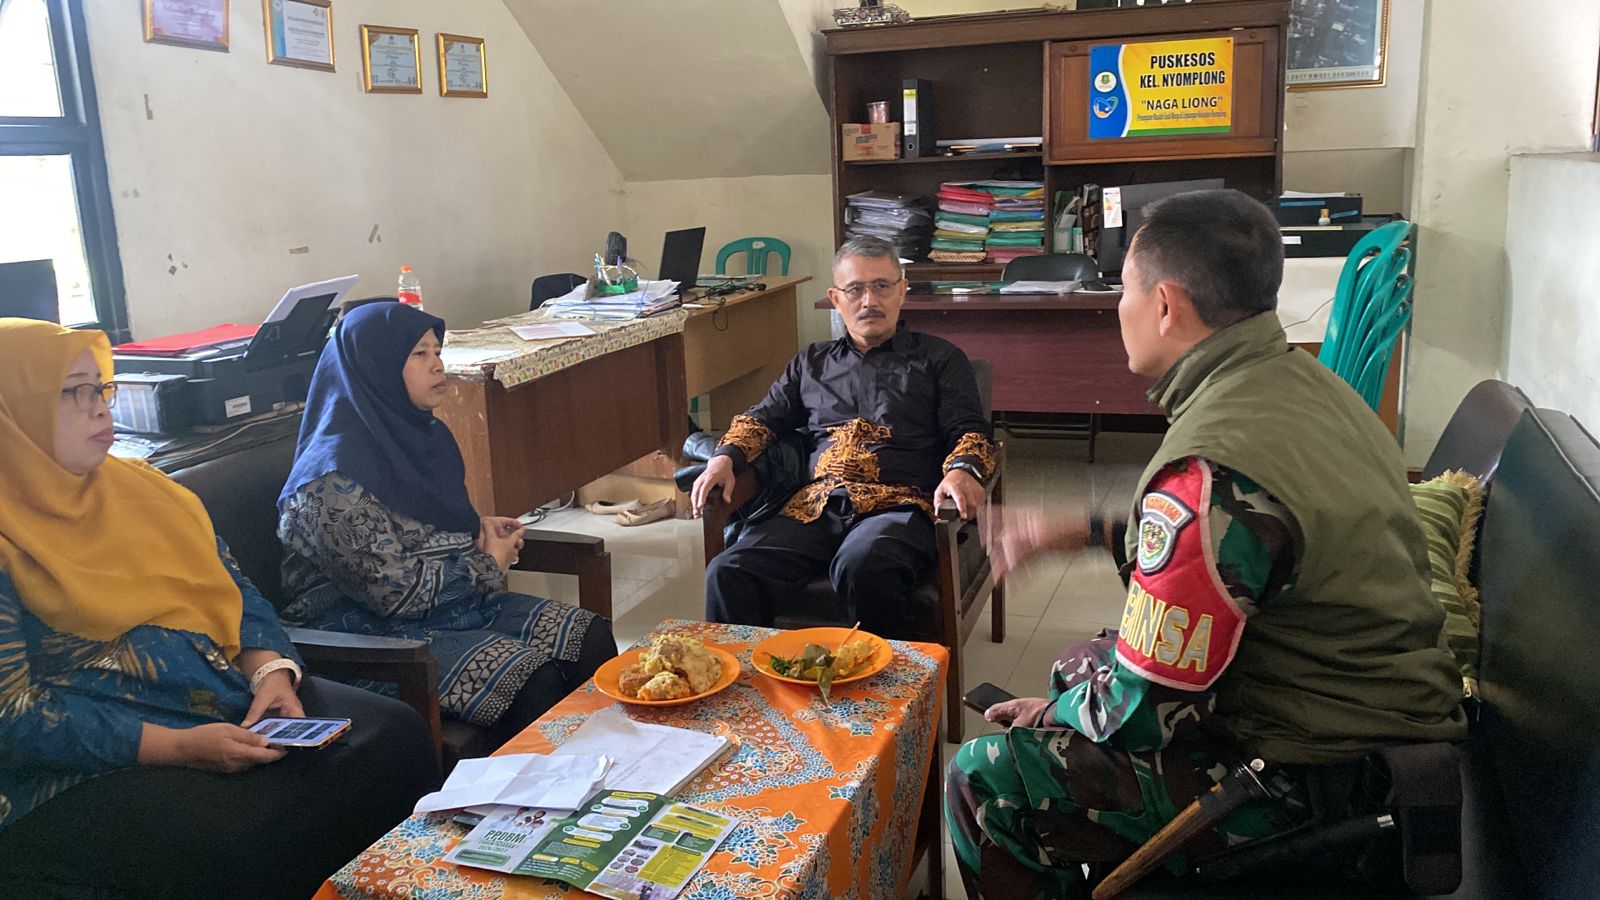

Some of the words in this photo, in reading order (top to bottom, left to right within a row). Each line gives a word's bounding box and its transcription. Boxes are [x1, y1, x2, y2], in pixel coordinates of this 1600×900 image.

[1150, 52, 1215, 69] PUSKESOS
[1140, 74, 1160, 89] KEL.
[1162, 70, 1225, 87] NYOMPLONG
